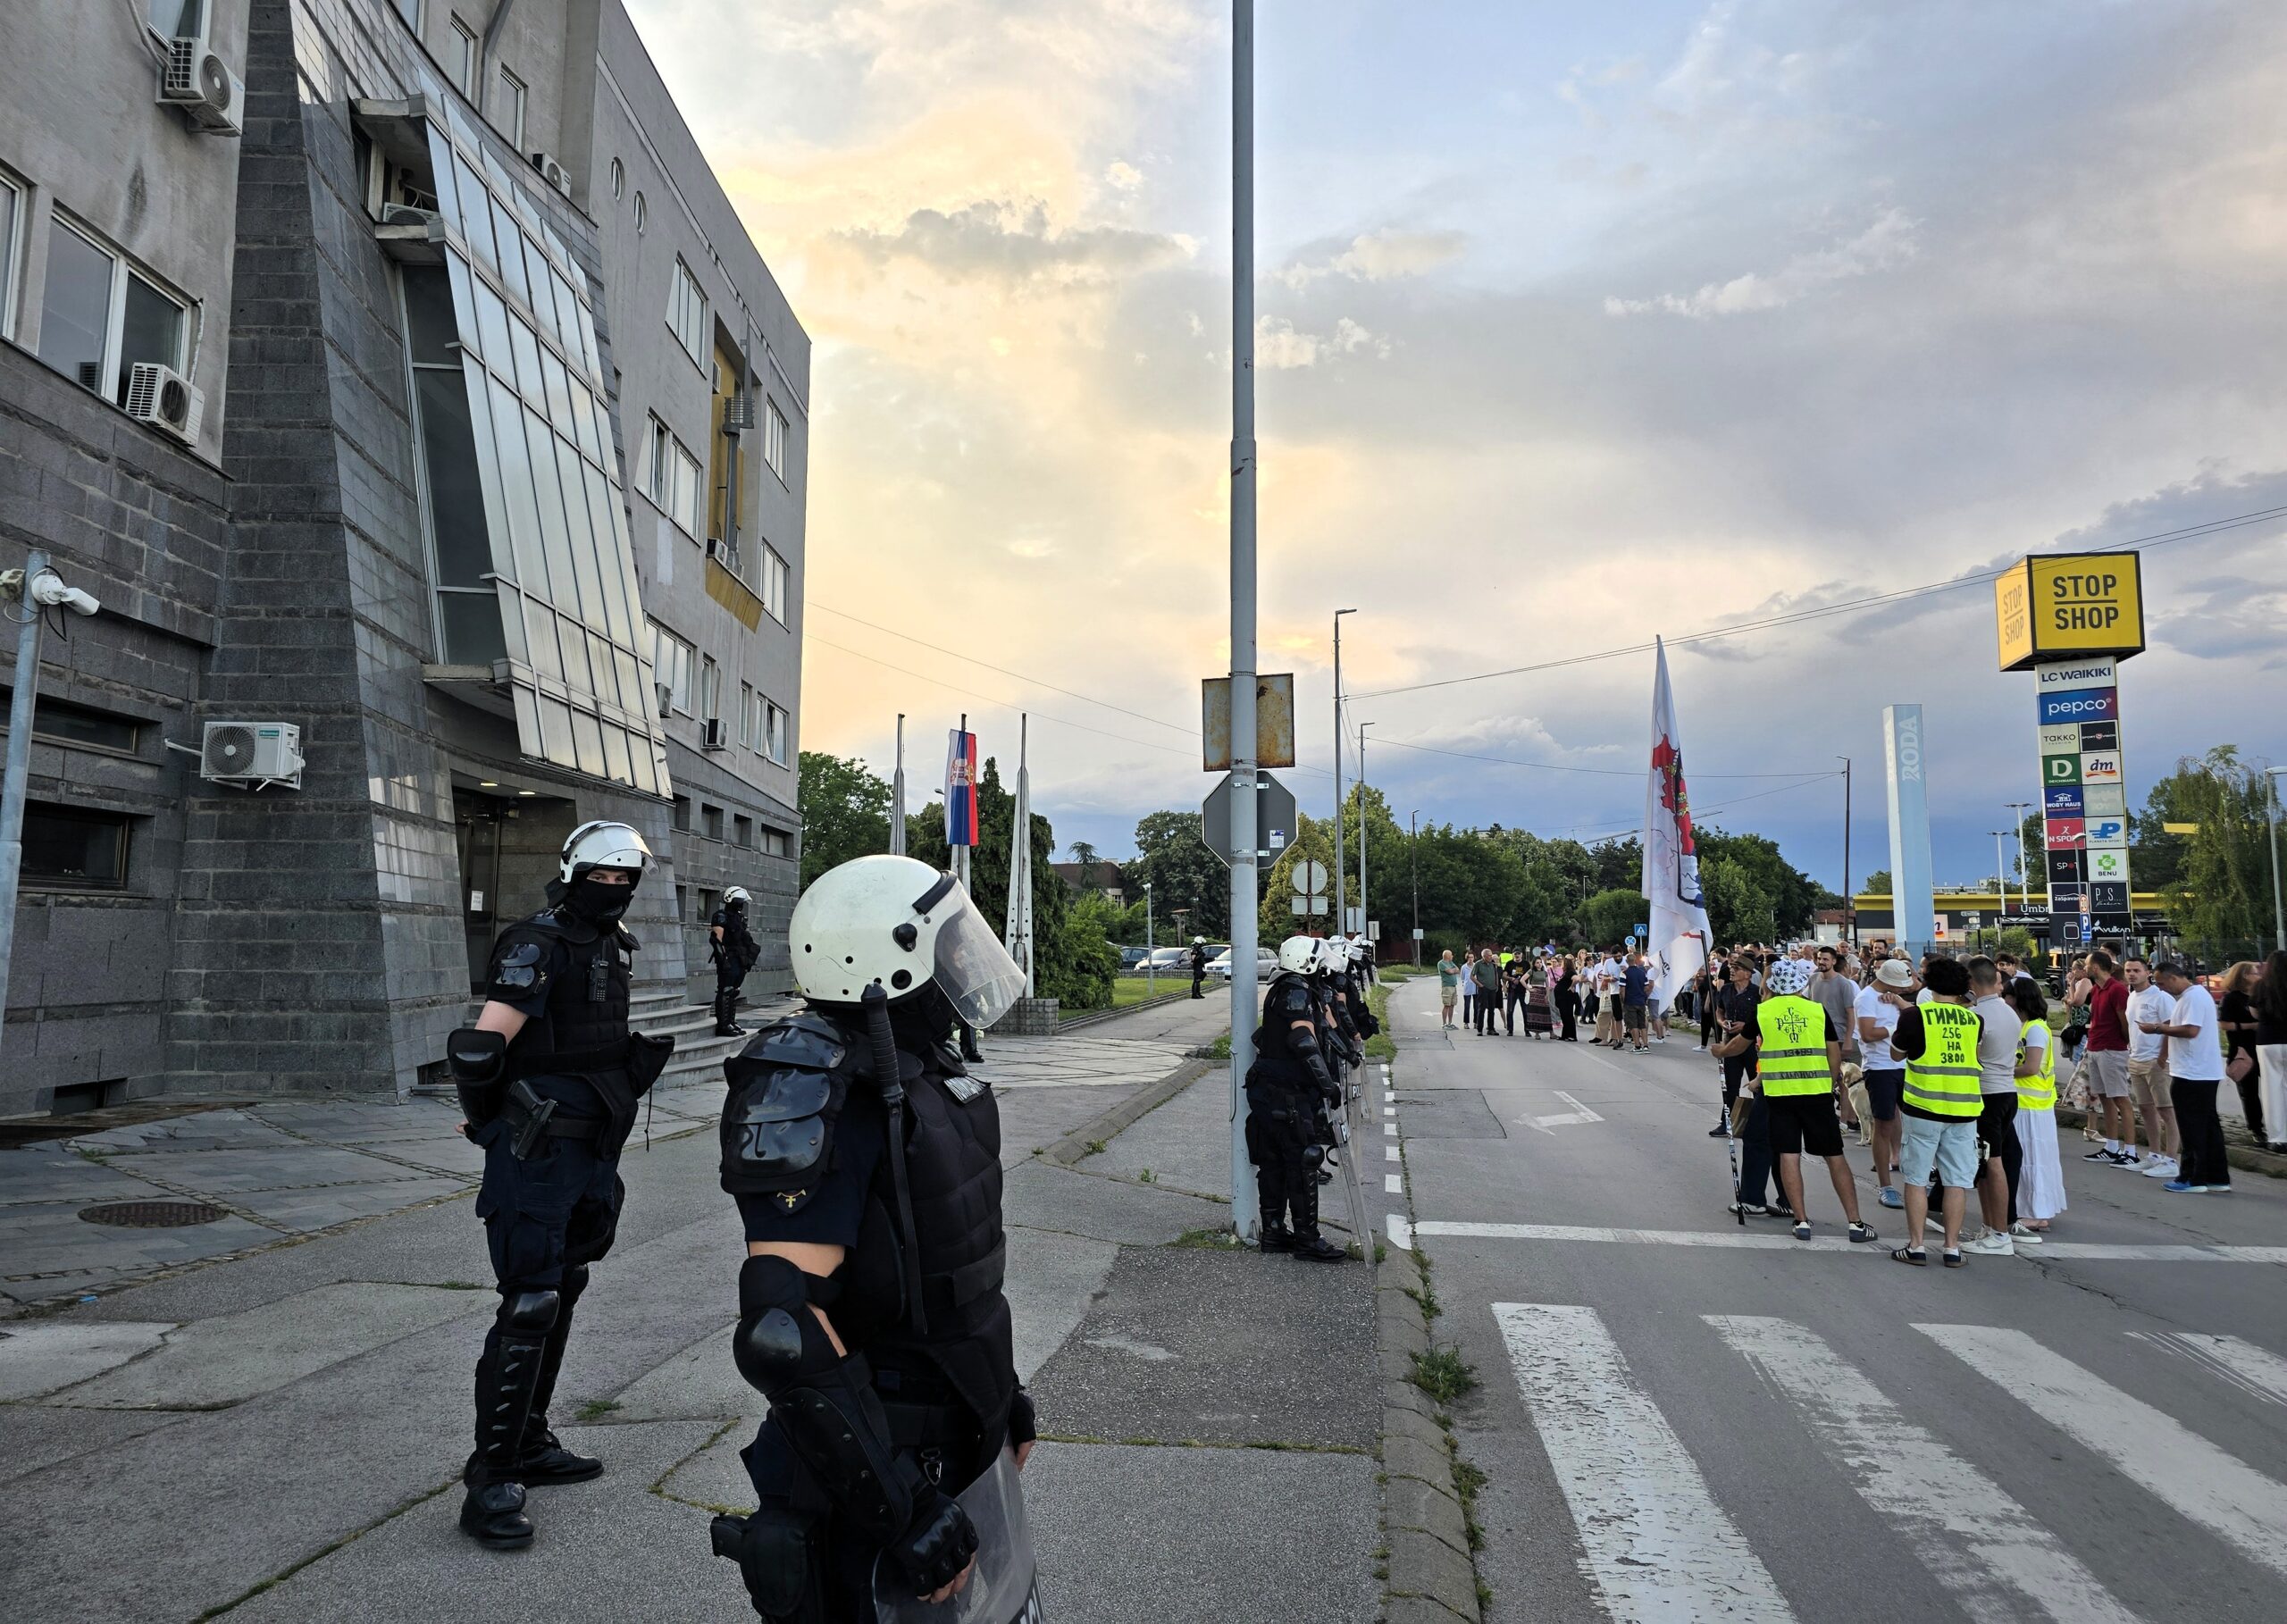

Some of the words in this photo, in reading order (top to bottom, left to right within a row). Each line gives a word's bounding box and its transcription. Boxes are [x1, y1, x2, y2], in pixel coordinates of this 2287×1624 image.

[2053, 574, 2117, 598] STOP
[2003, 584, 2023, 615] STOP
[2055, 607, 2119, 631] SHOP
[2005, 615, 2024, 645] SHOP
[2041, 672, 2058, 682] LC
[2048, 699, 2107, 716] pepco
[1898, 715, 1921, 782] RODA
[2090, 759, 2114, 771] dm
[1942, 1027, 1962, 1039] 256
[1940, 1052, 1964, 1064] 3800
